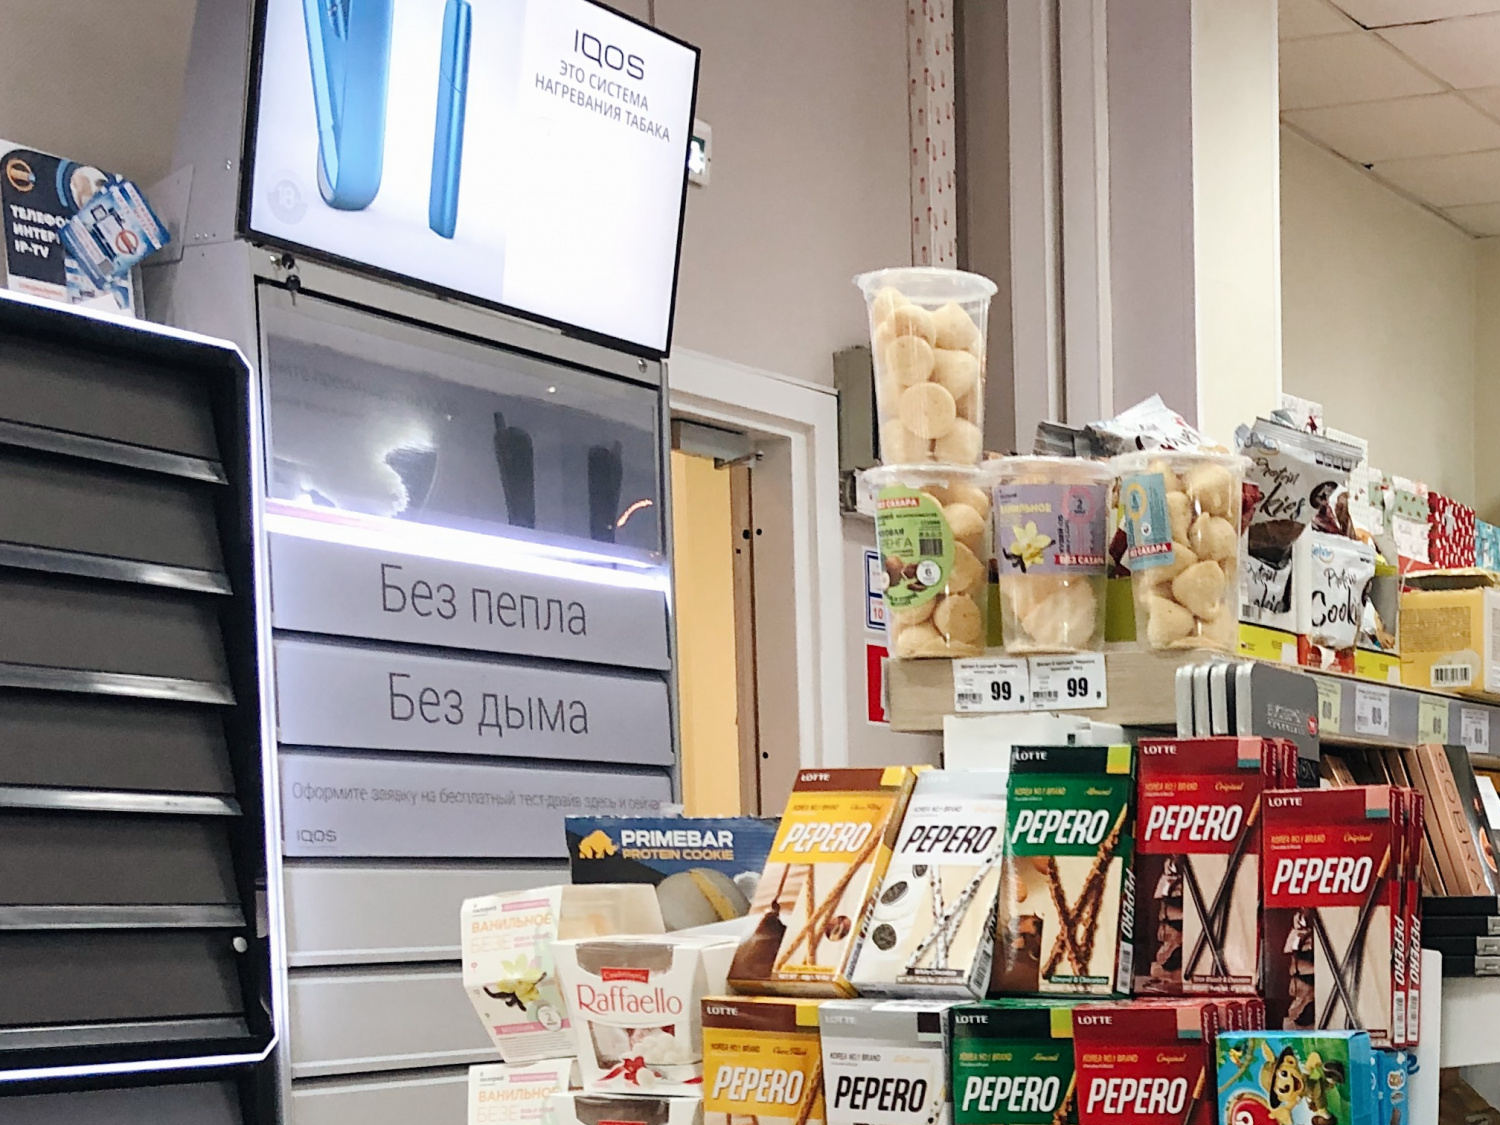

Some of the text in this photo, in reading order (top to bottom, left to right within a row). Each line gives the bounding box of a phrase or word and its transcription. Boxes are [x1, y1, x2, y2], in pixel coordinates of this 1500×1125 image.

[574, 29, 645, 80] IQOS
[559, 59, 649, 111] ЭТО СИСТЕМА
[535, 73, 670, 142] НАГРЕВАНИЯ ТАБАКА
[381, 563, 587, 636] Без пепла
[990, 680, 1012, 701] 99
[1066, 677, 1089, 698] 99
[389, 672, 588, 737] Без дыма
[1014, 751, 1048, 761] LOTTE
[1143, 745, 1178, 755] LOTTE
[801, 772, 831, 782] LOTTE
[1267, 796, 1303, 807] LOTTE
[296, 829, 338, 843] IQOS
[621, 829, 734, 848] PRIMEBAR
[778, 821, 873, 853] PEPERO
[1011, 809, 1110, 845] PEPERO
[1145, 804, 1243, 842] PEPERO
[621, 848, 734, 861] PROTEIN COOKIE
[901, 825, 998, 854] PEPERO
[1271, 856, 1374, 896] PEPERO
[1120, 867, 1137, 940] PEPERO
[471, 913, 552, 934] ВАНИЛЬНОЕ
[1393, 914, 1405, 987] PEPERO
[1409, 913, 1421, 985] PEPERO
[576, 983, 683, 1016] Raffaello
[706, 1006, 739, 1016] LOTTE
[955, 1014, 989, 1025] LOTTE
[1078, 1015, 1113, 1025] LOTTE
[712, 1065, 805, 1105] PEPERO
[834, 1075, 928, 1113] PEPERO
[962, 1075, 1061, 1113] PEPERO
[1086, 1077, 1188, 1115] PEPERO
[477, 1105, 518, 1123] БЕЗЕ
